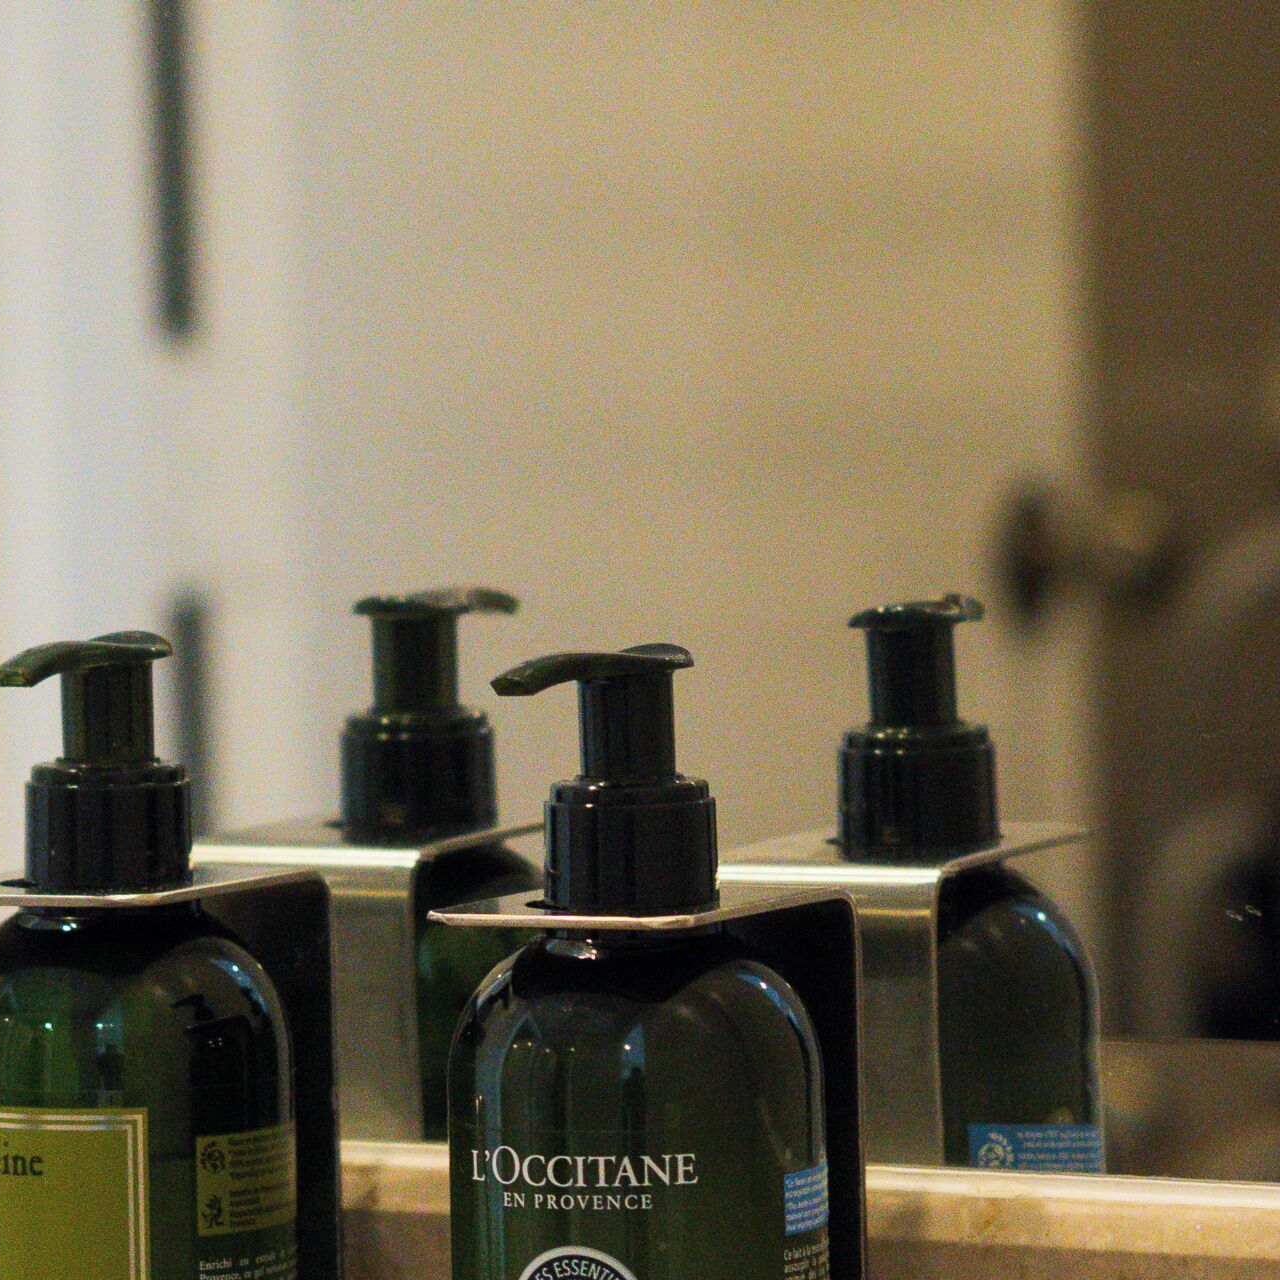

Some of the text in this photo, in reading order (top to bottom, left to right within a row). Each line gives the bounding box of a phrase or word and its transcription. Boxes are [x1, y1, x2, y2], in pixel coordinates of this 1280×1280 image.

[471, 1145, 699, 1188] L'OCCITANE
[503, 1191, 653, 1211] EN PROVENCE
[199, 1257, 233, 1271] Enrichi
